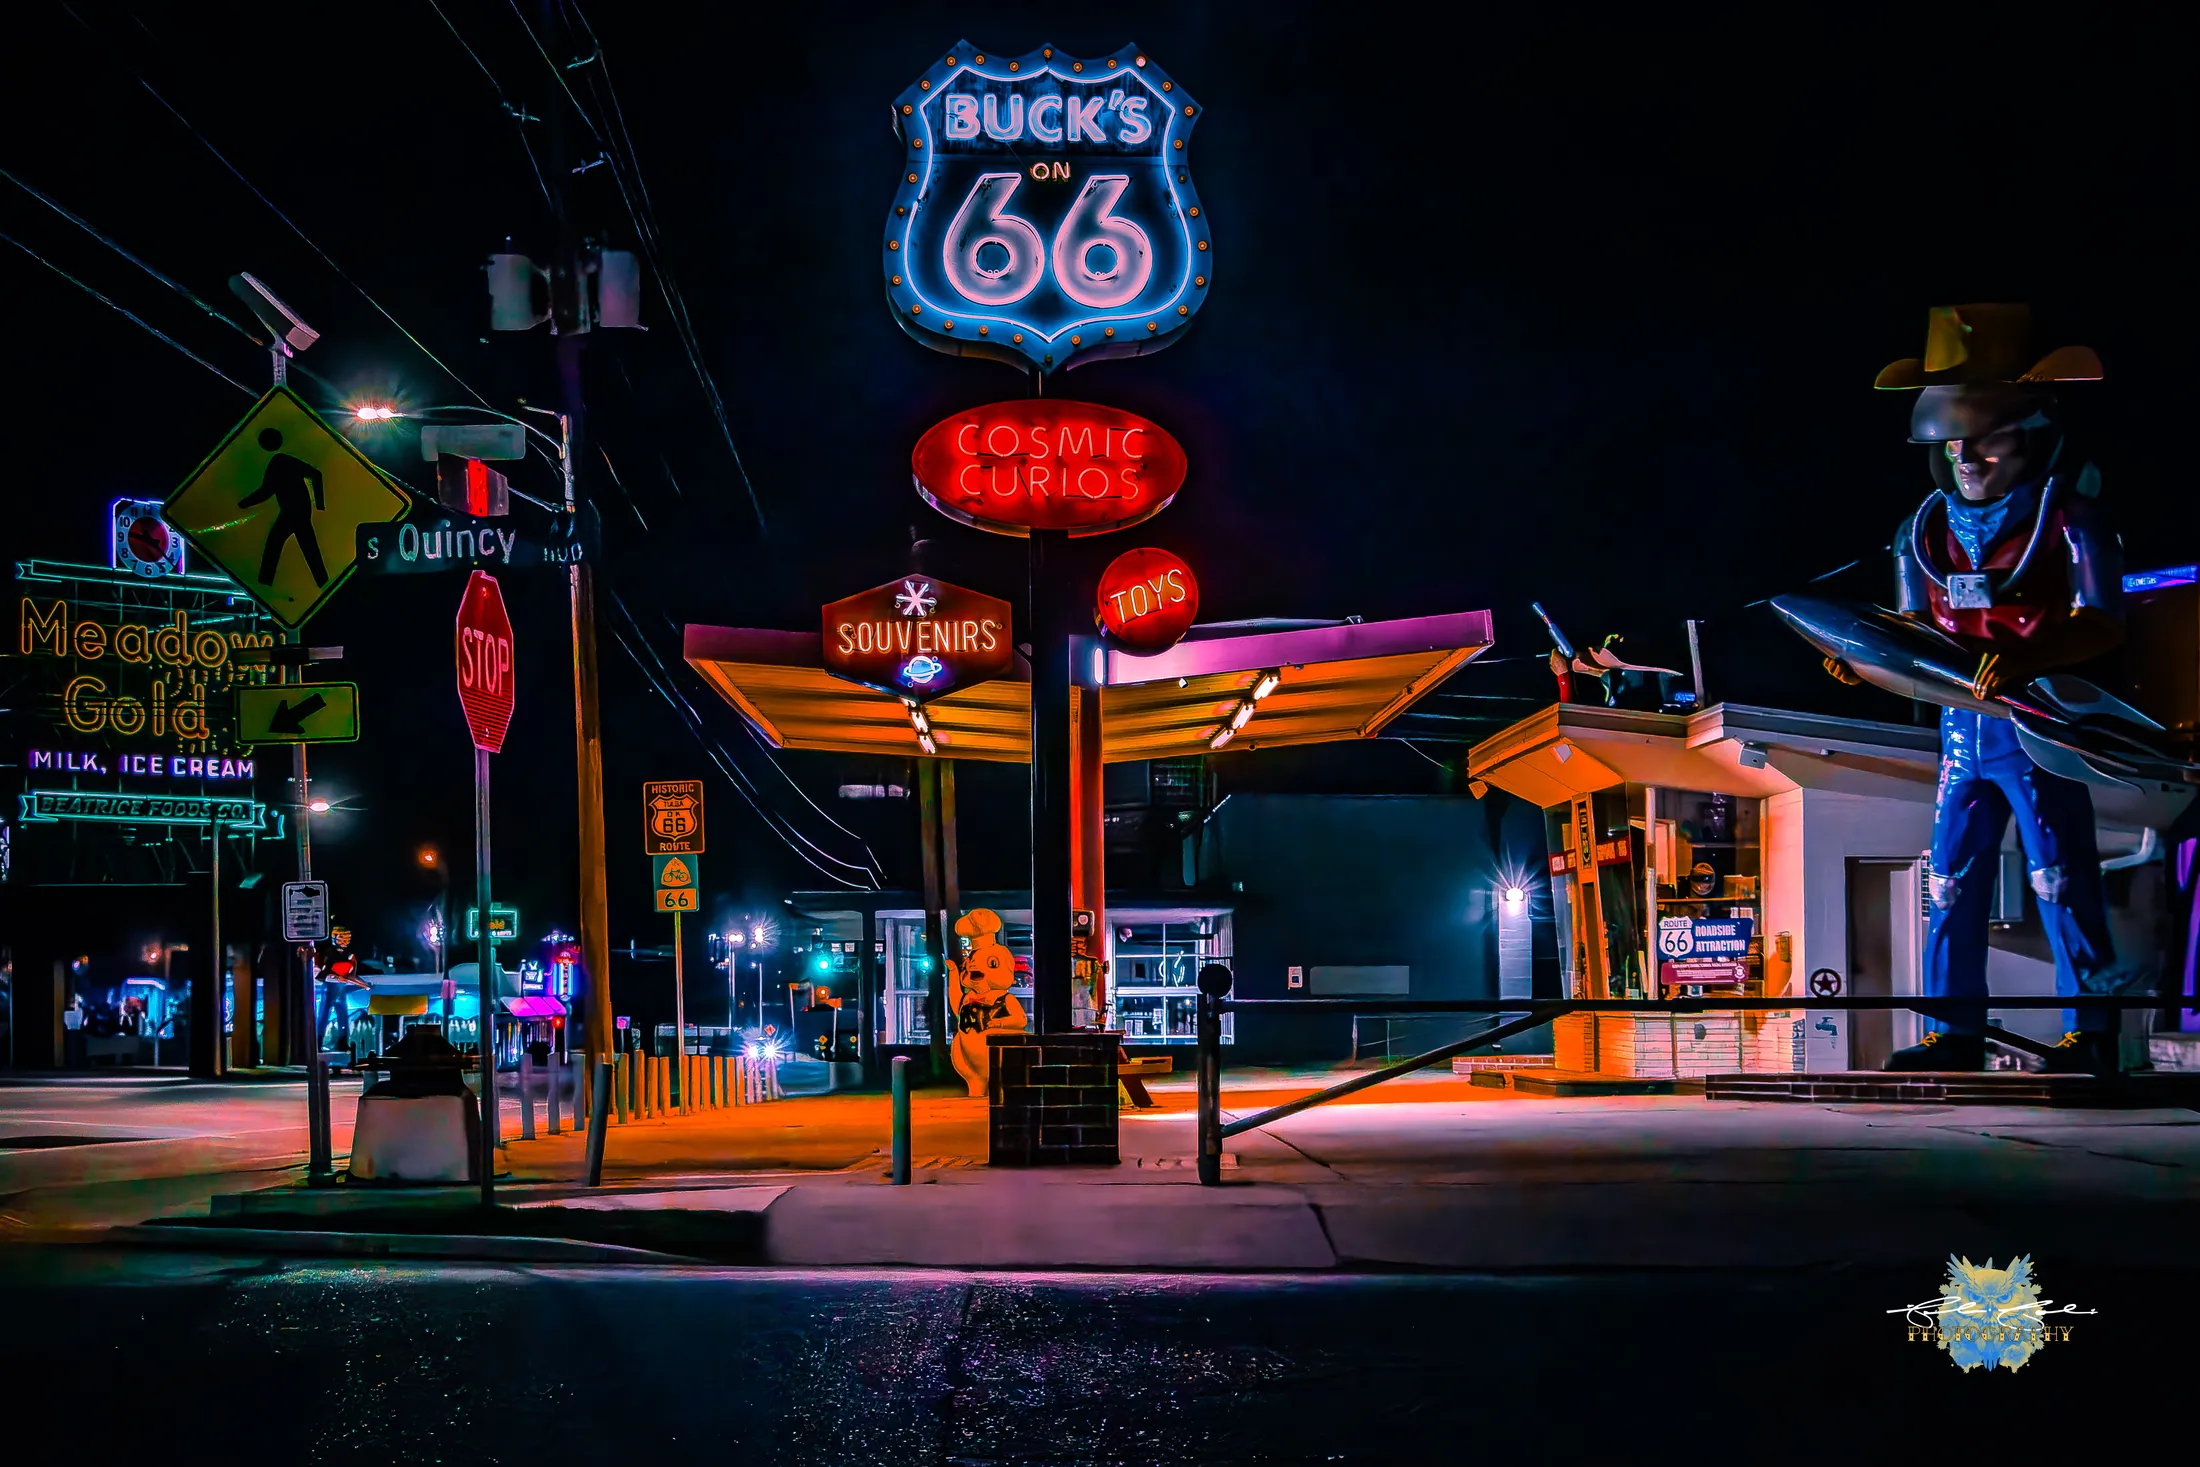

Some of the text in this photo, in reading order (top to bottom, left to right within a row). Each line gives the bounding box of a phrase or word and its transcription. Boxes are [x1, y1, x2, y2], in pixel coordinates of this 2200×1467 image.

[945, 90, 1152, 144] BUCK'S
[1031, 161, 1071, 181] ON
[943, 172, 1153, 309] 66
[957, 423, 1144, 459] COSMIC
[959, 464, 1140, 500] CURIOS
[120, 516, 131, 528] 10
[117, 531, 125, 543] 9
[171, 537, 179, 549] 3
[399, 519, 517, 565] Quincy
[121, 547, 129, 559] 8
[144, 564, 153, 576] 6
[1109, 568, 1187, 625] TOYS
[838, 618, 998, 655] SOUVENIRS
[462, 626, 509, 697] STOP
[64, 675, 210, 740] Gold
[32, 751, 255, 779] MILK, ICE CREAM
[651, 783, 695, 794] HISTORIC
[40, 796, 247, 819] BEATRICE FOODS CO.
[663, 817, 687, 833] 66
[659, 842, 691, 852] ROUTE
[664, 891, 689, 908] 66
[1663, 920, 1688, 928] ROUTE
[1695, 925, 1737, 937] ROADSIDE
[1665, 930, 1688, 953] 66
[1695, 939, 1746, 953] ATTRACTION
